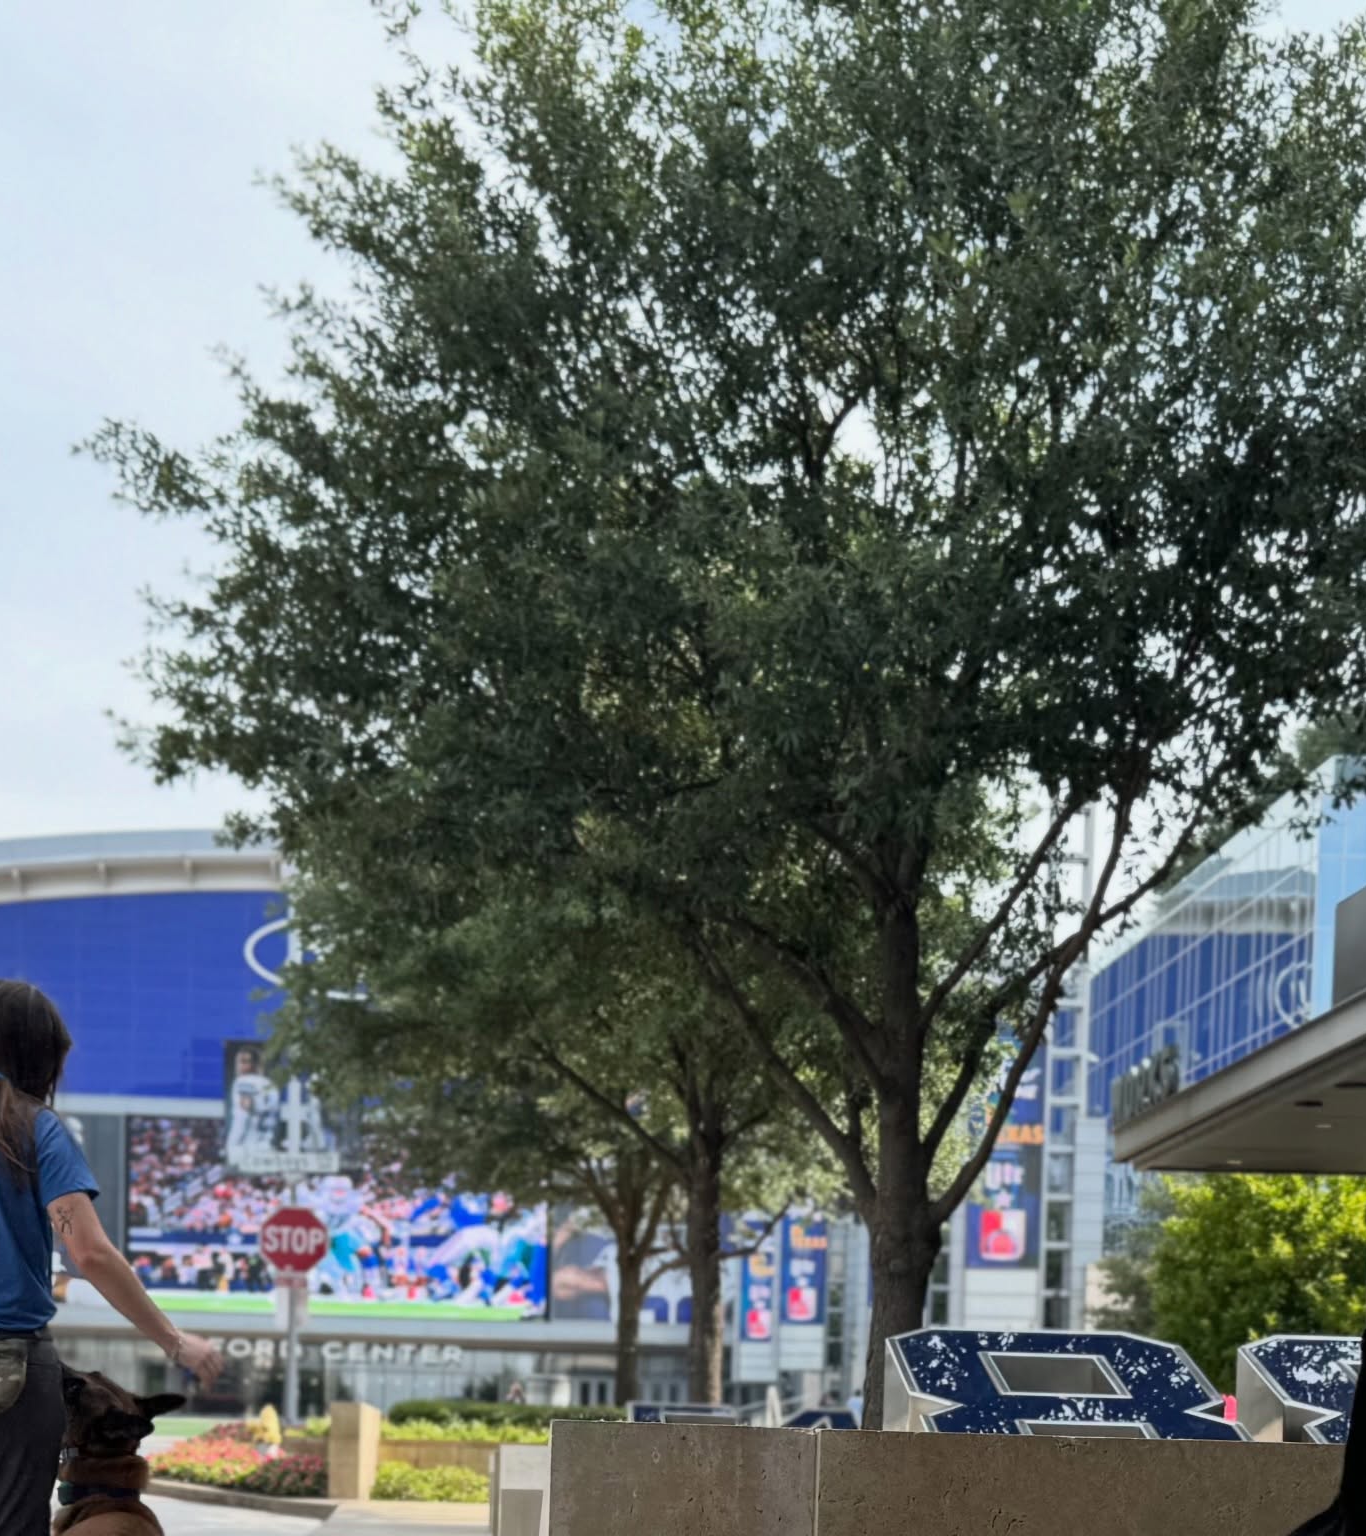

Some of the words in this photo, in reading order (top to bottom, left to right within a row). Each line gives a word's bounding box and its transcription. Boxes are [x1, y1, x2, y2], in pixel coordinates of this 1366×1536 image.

[996, 1124, 1045, 1145] EXAS
[265, 1225, 324, 1254] STOP
[322, 1340, 462, 1365] CENTER
